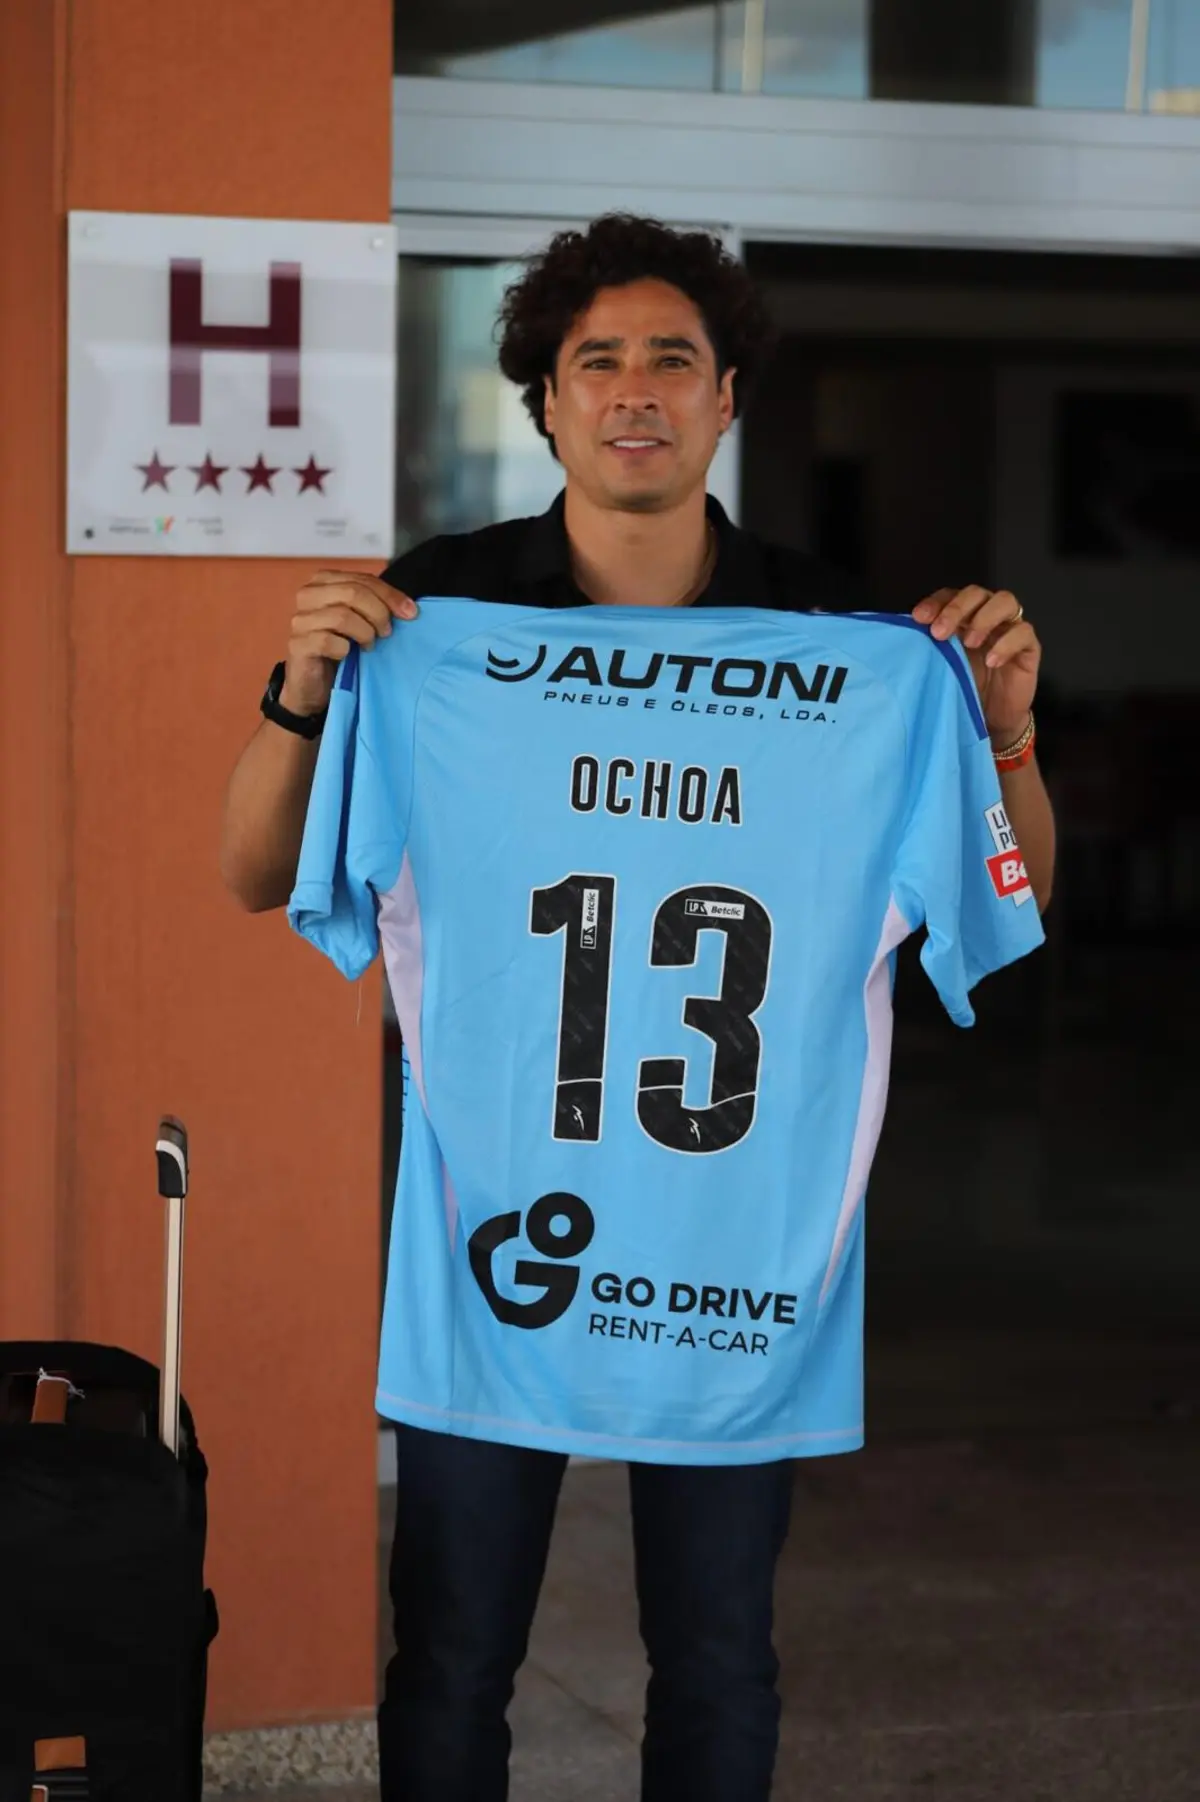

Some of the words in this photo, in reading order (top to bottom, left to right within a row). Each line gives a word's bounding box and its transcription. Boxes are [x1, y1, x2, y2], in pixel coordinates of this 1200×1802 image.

[168, 257, 301, 428] H
[546, 646, 848, 704] AUTONI
[544, 691, 629, 707] PNEUS
[644, 698, 656, 709] E
[780, 709, 836, 723] LDA.
[569, 753, 742, 826] OCHOA
[528, 872, 773, 1155] 13
[591, 1272, 656, 1308] GO
[668, 1282, 798, 1325] DRIVE
[589, 1313, 769, 1355] RENT-A-CAR
